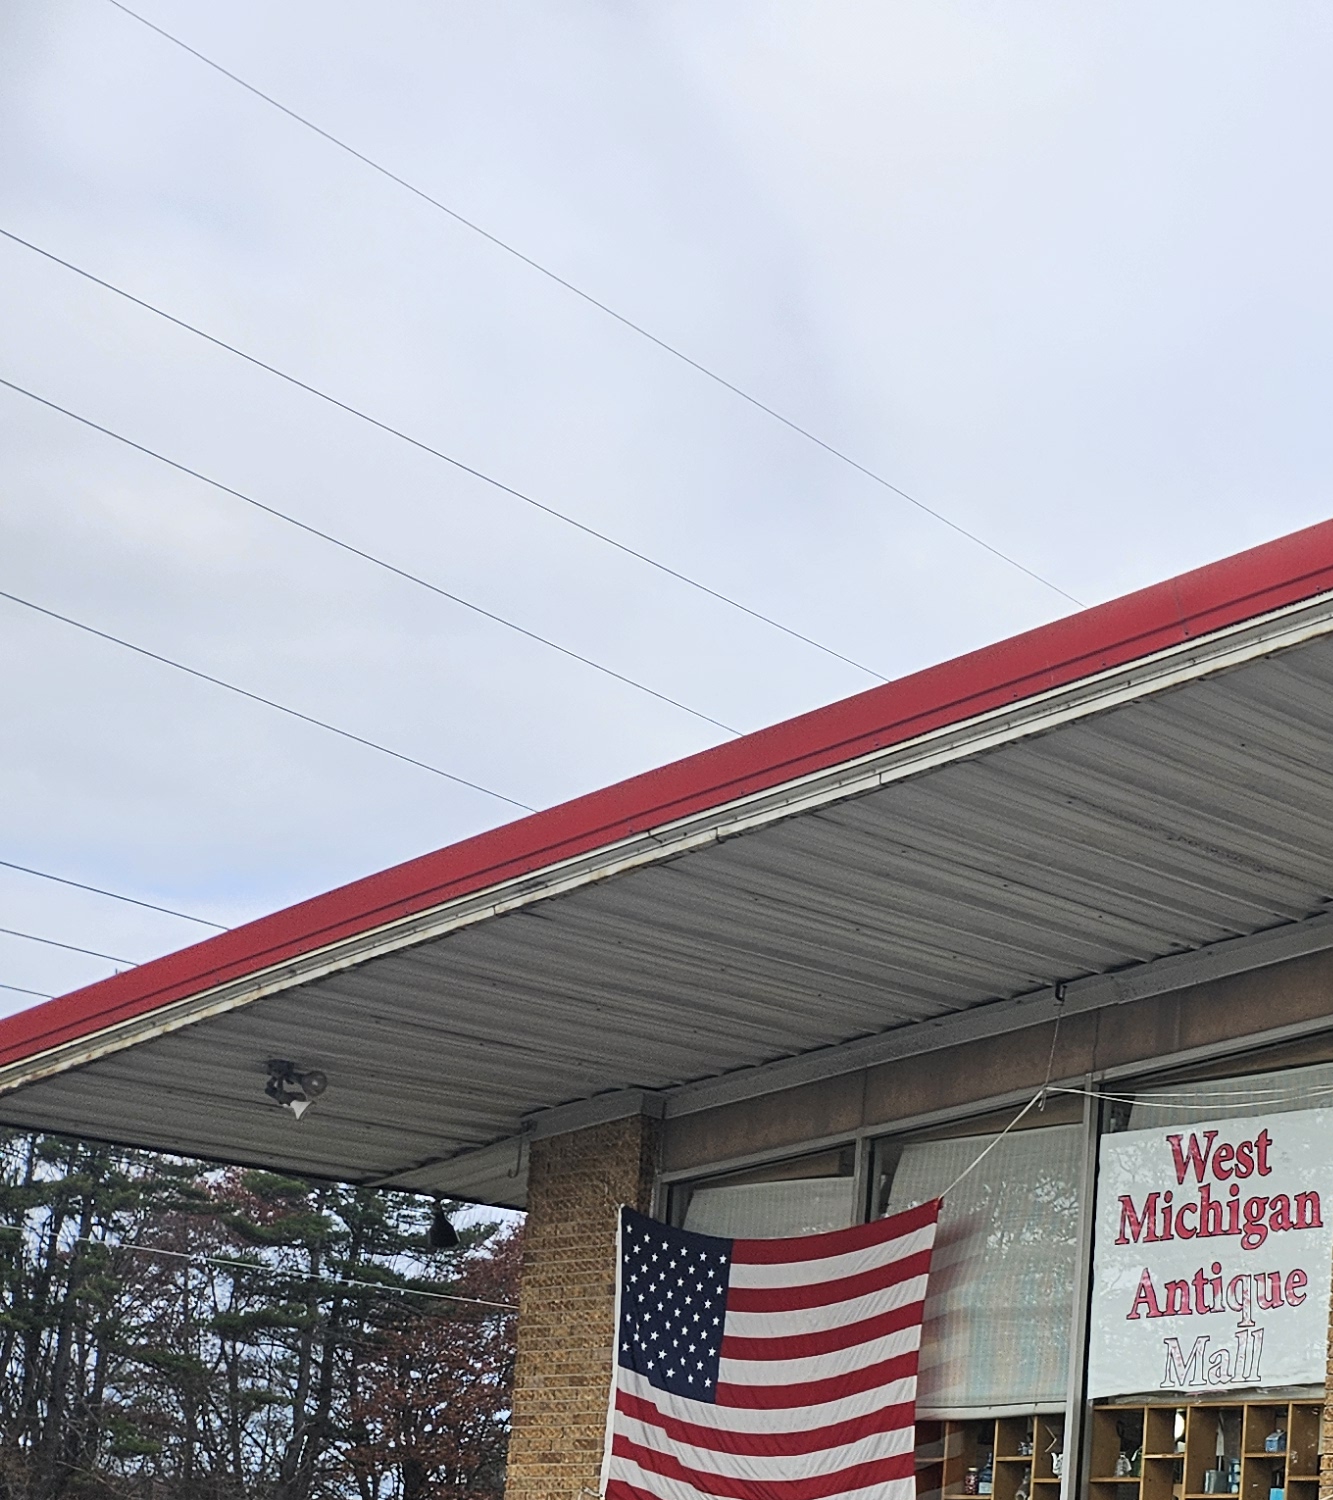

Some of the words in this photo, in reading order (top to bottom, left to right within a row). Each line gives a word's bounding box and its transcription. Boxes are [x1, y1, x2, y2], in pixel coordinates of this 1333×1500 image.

[1166, 1128, 1273, 1184] West
[1115, 1182, 1323, 1251] Michigan
[1126, 1262, 1308, 1327] Antique
[1160, 1328, 1264, 1388] Mall
